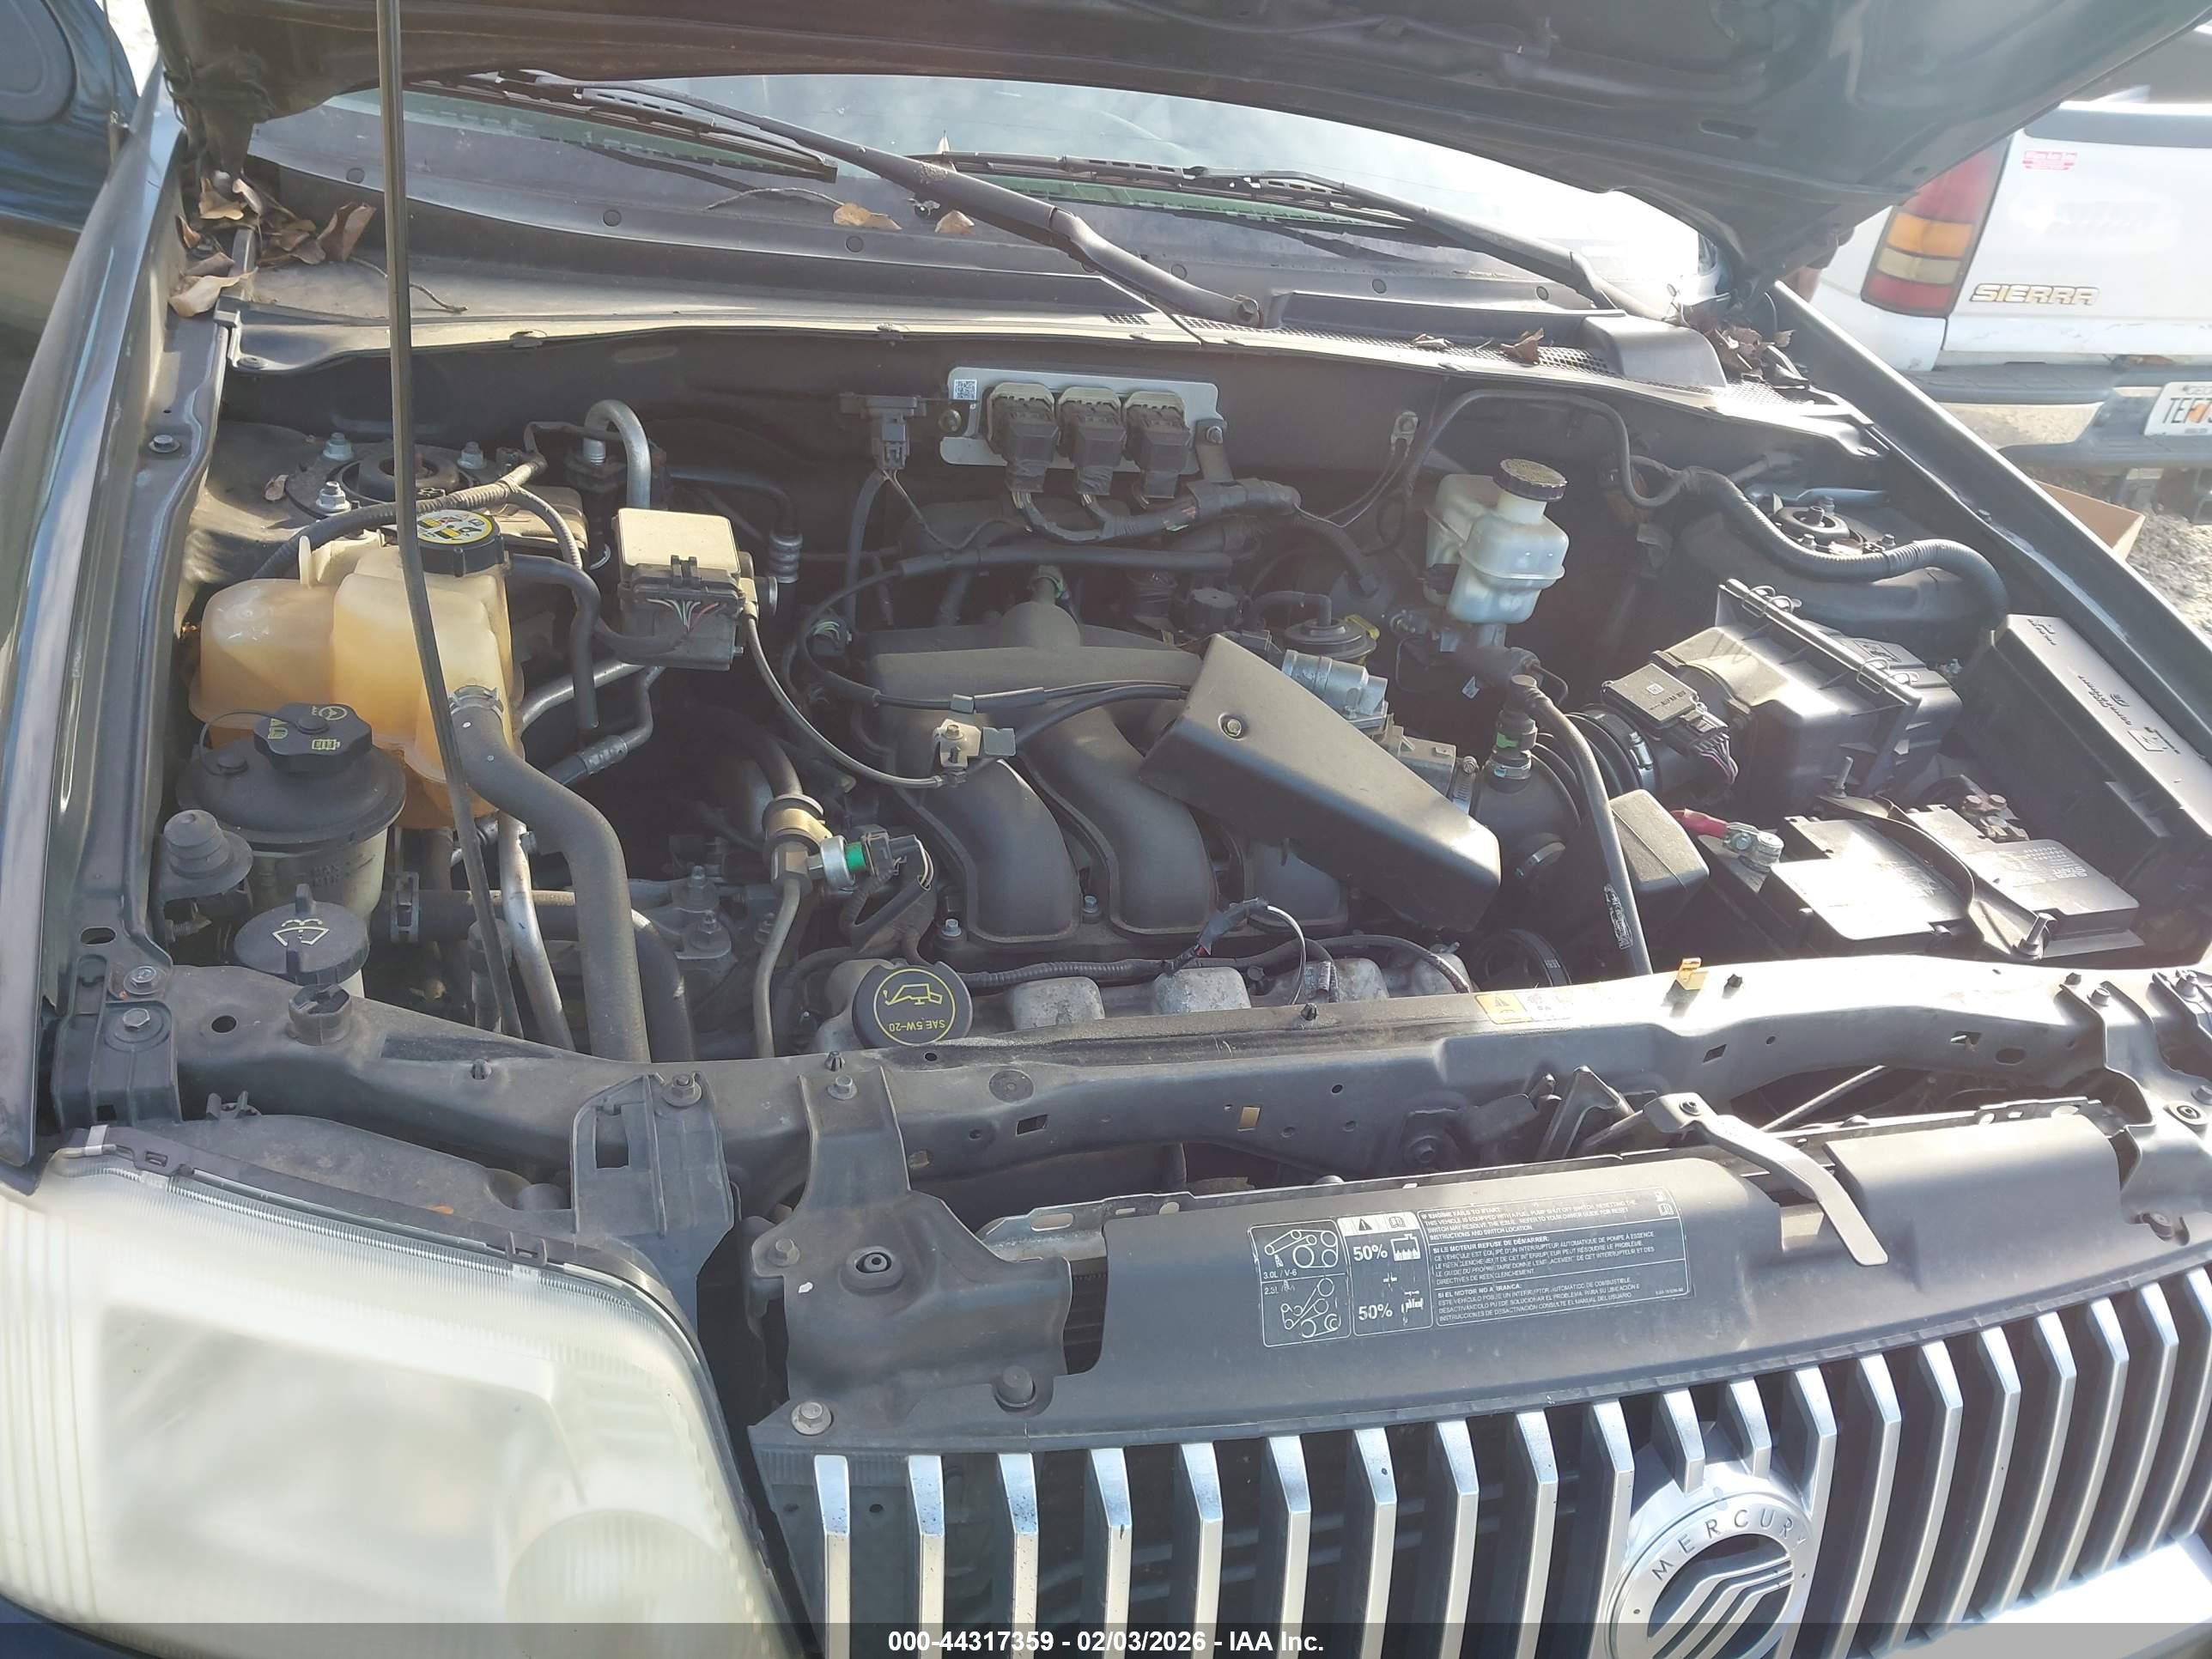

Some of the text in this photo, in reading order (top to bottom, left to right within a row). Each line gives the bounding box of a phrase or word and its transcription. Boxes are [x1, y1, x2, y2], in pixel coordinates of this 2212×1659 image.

[1970, 283, 2100, 306] SIERRA
[889, 1019, 945, 1032] SAE 5W-20
[1430, 1231, 1470, 1240] INSTRUCTIONS
[1449, 1243, 1477, 1252] MOTEUR
[1560, 1238, 1597, 1248] AUTOMATIQUE
[1352, 1243, 1389, 1261] 50%
[1263, 1270, 1279, 1279] 3.0L
[1284, 1268, 1297, 1277] V-6
[1437, 1276, 1469, 1285] DIRECTIVES
[1358, 1303, 1394, 1321] 50%
[1651, 1508, 1806, 1582] MERCURY
